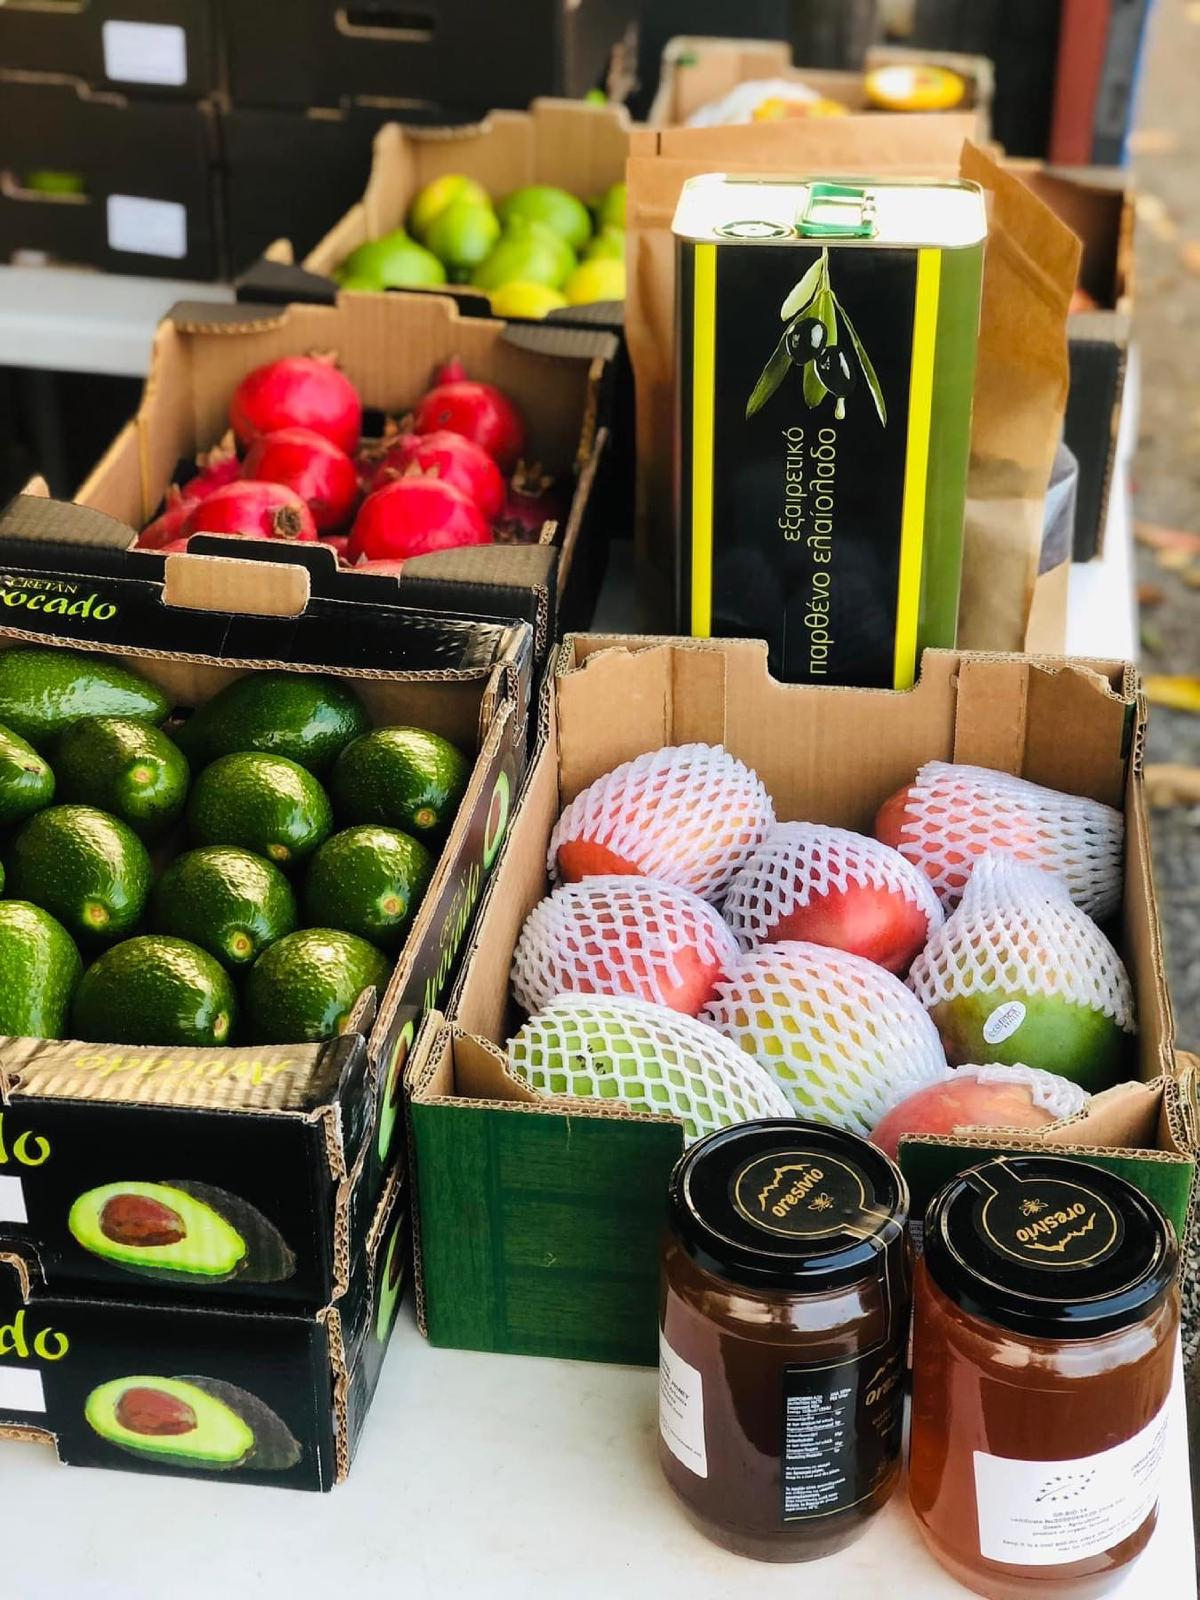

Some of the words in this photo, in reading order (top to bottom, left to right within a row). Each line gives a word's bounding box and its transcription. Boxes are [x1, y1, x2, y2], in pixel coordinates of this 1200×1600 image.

[778, 426, 807, 542] εξαιρετικό
[807, 428, 836, 564] ελαίολαδο
[0, 588, 117, 620] ocado
[10, 578, 79, 594] CRETAN
[804, 572, 834, 674] παρθένο
[75, 1055, 294, 1087] Avocado
[772, 1168, 825, 1218] oresivio
[1016, 1202, 1087, 1242] oresivio
